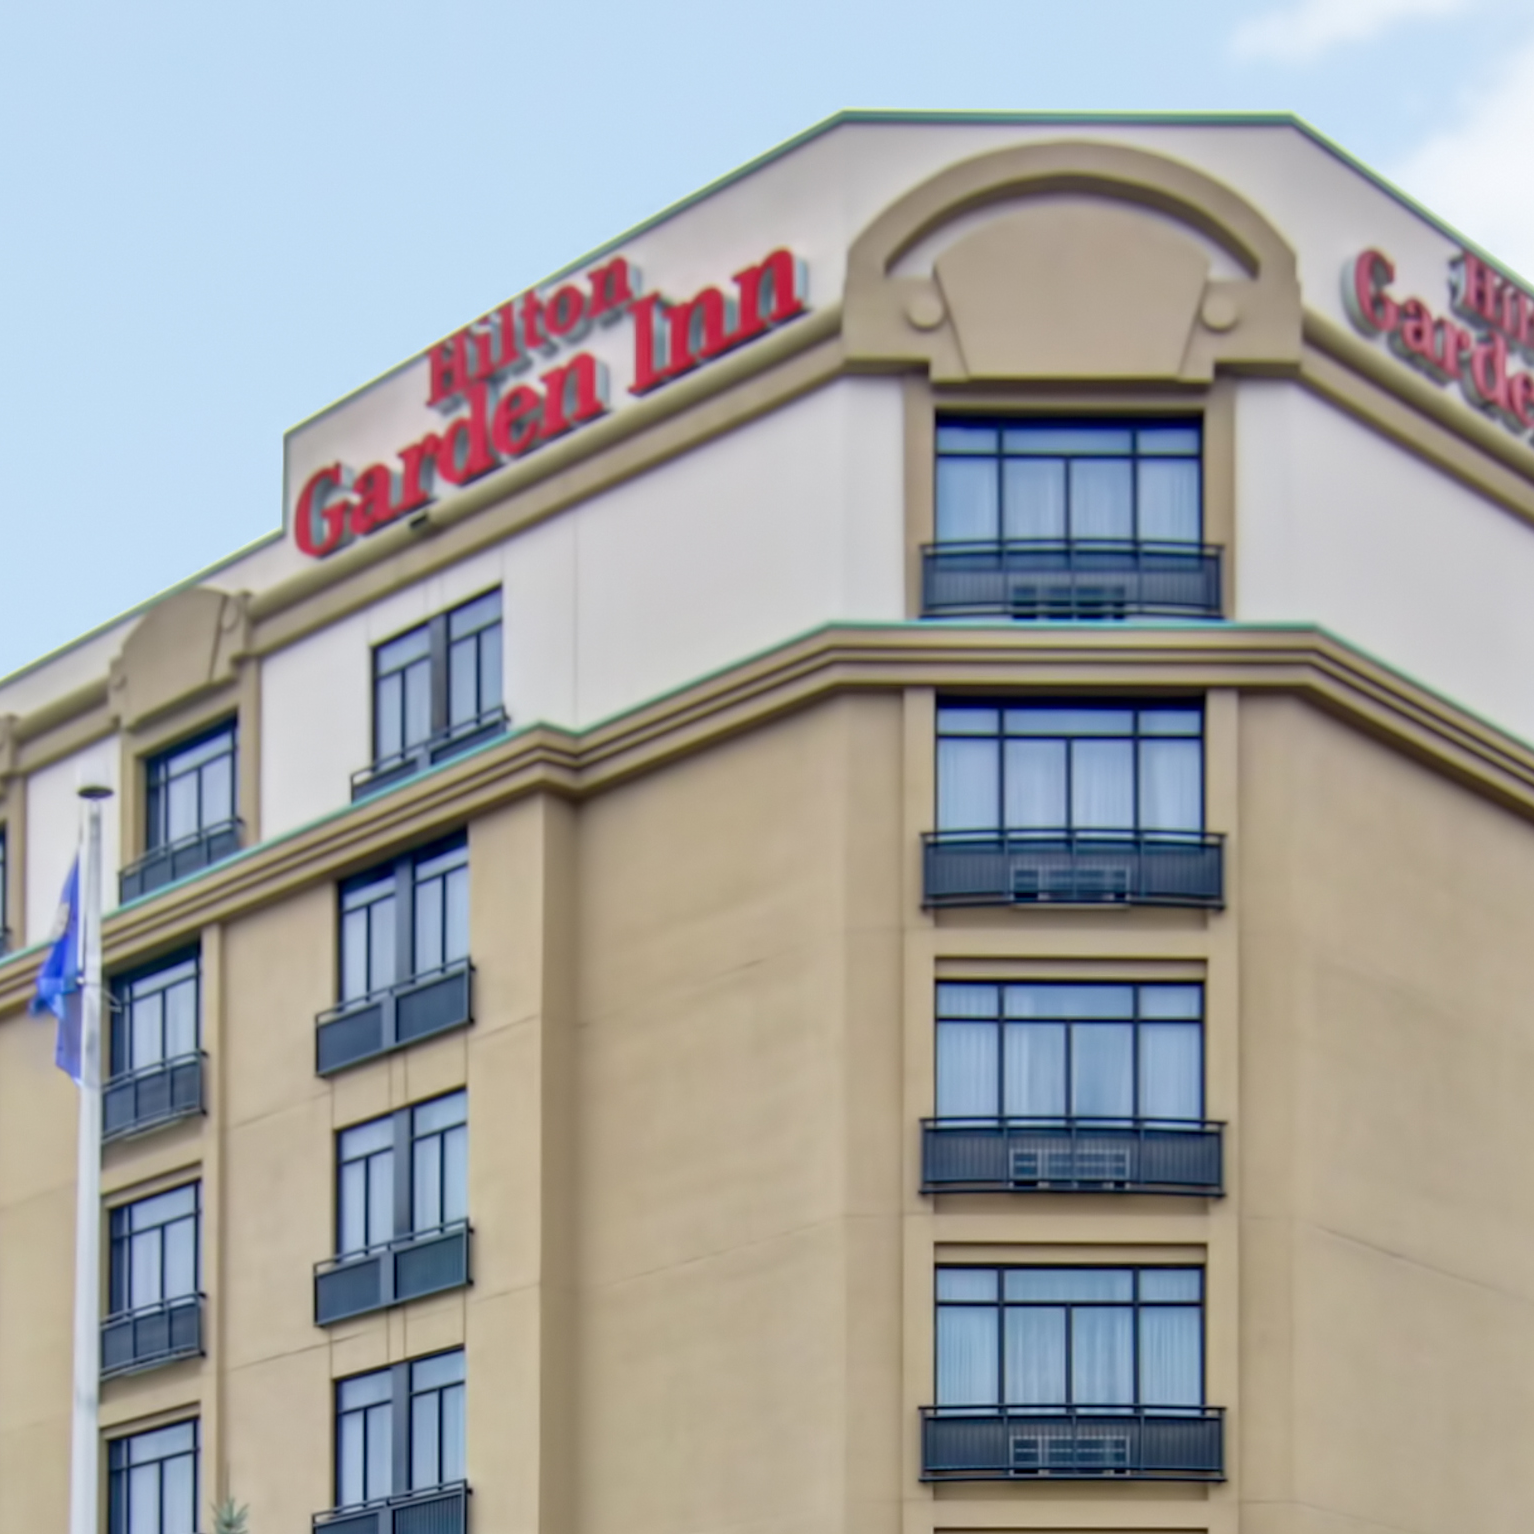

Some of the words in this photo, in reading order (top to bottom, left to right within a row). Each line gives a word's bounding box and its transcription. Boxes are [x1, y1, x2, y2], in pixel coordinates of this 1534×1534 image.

[294, 352, 605, 557] Garden
[628, 247, 804, 394] Inn
[425, 256, 635, 408] Hilton
